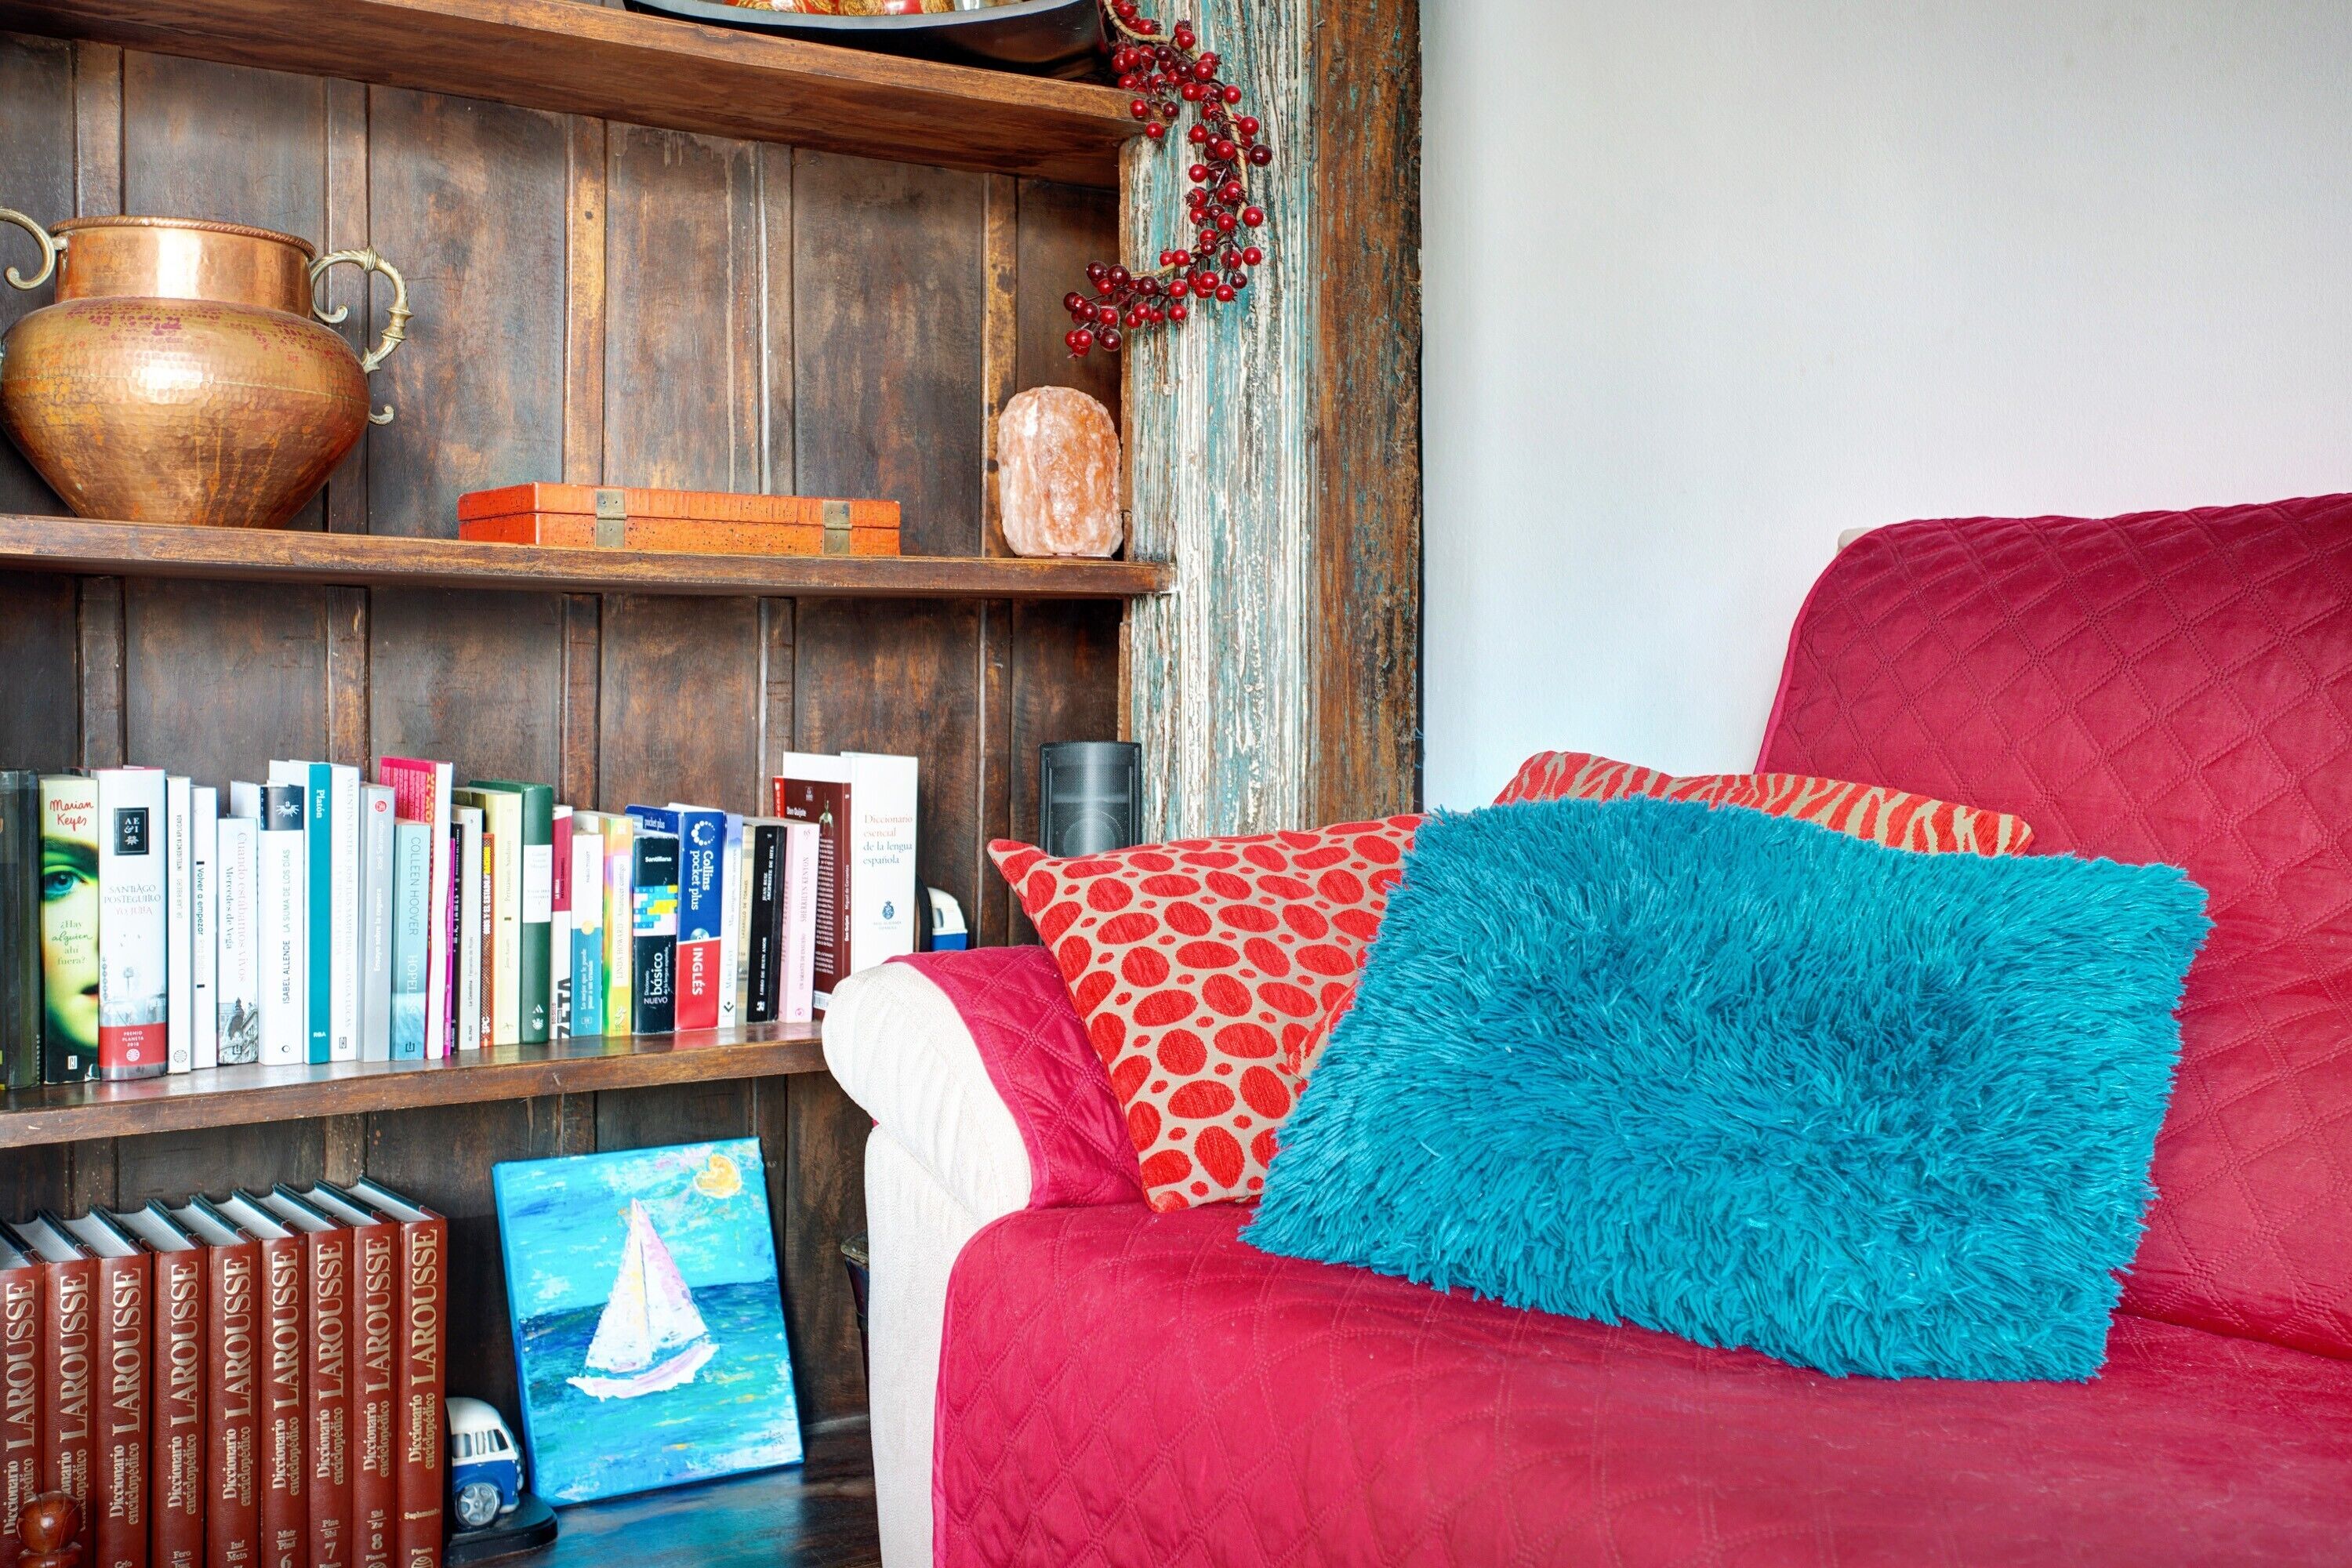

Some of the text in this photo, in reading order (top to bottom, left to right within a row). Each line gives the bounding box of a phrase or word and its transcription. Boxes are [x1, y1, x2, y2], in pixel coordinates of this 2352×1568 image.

[49, 799, 94, 811] Marian
[56, 813, 87, 831] Keyes
[316, 789, 326, 818] Platón
[644, 816, 666, 831] pocket plus
[865, 814, 913, 823] Diccionario
[237, 832, 249, 880] Cuando
[863, 827, 896, 837] esencial
[863, 841, 913, 853] de la lengua
[196, 867, 205, 891] Volver
[408, 837, 421, 936] COLLEEN HOOVER
[688, 850, 702, 911] pocket plus
[702, 850, 714, 891] Collins
[862, 854, 899, 868] española
[103, 894, 162, 904] POSTEGUILLO
[109, 884, 157, 894] SANTIAGO
[224, 866, 234, 949] Mercedes de Vega
[282, 887, 290, 897] DE
[800, 856, 809, 923] SHERRILYN KENYON
[52, 931, 93, 946] alguien
[195, 901, 204, 935] empezar
[282, 923, 290, 933] LA
[615, 923, 624, 954] HOWARD
[238, 950, 248, 982] vivos
[373, 946, 383, 972] Ensayo
[649, 952, 663, 996] básico
[691, 946, 706, 996] INGLÉS
[557, 977, 571, 1039] ZETA
[643, 996, 669, 1005] NUEVO
[272, 1248, 299, 1411] LAROUSSE
[317, 1241, 343, 1402] LAROUSSE
[365, 1236, 391, 1395] LAROUSSE
[411, 1229, 437, 1387] LAROUSSE
[5, 1279, 35, 1452] LAROUSSE
[60, 1272, 89, 1443] LAROUSSE
[112, 1267, 141, 1436] LAROUSSE
[170, 1261, 198, 1428] LAROUSSE
[223, 1255, 251, 1421] LAROUSSE
[271, 1418, 286, 1489] Diccionario
[317, 1408, 331, 1479] Diccionario
[331, 1406, 346, 1486] enciclopédico
[363, 1402, 377, 1471] Diccionario
[377, 1399, 392, 1478] enciclopédico
[408, 1394, 423, 1463] Diccionario
[422, 1392, 437, 1470] enciclopédico
[57, 1451, 72, 1495] onario
[109, 1444, 125, 1518] Diccionario
[125, 1442, 142, 1525] enciclopédico
[167, 1436, 182, 1508] Diccionario
[183, 1433, 199, 1515] enciclopédico
[223, 1428, 237, 1500] Diccionario
[238, 1425, 253, 1507] enciclopédico
[286, 1416, 302, 1497] enciclopédico
[3, 1460, 19, 1535] Diccionario
[404, 1508, 440, 1520] Suplemento
[172, 1550, 191, 1559] Fero
[280, 1553, 292, 1568] 6
[325, 1541, 336, 1559] 7
[371, 1533, 383, 1551] 8
